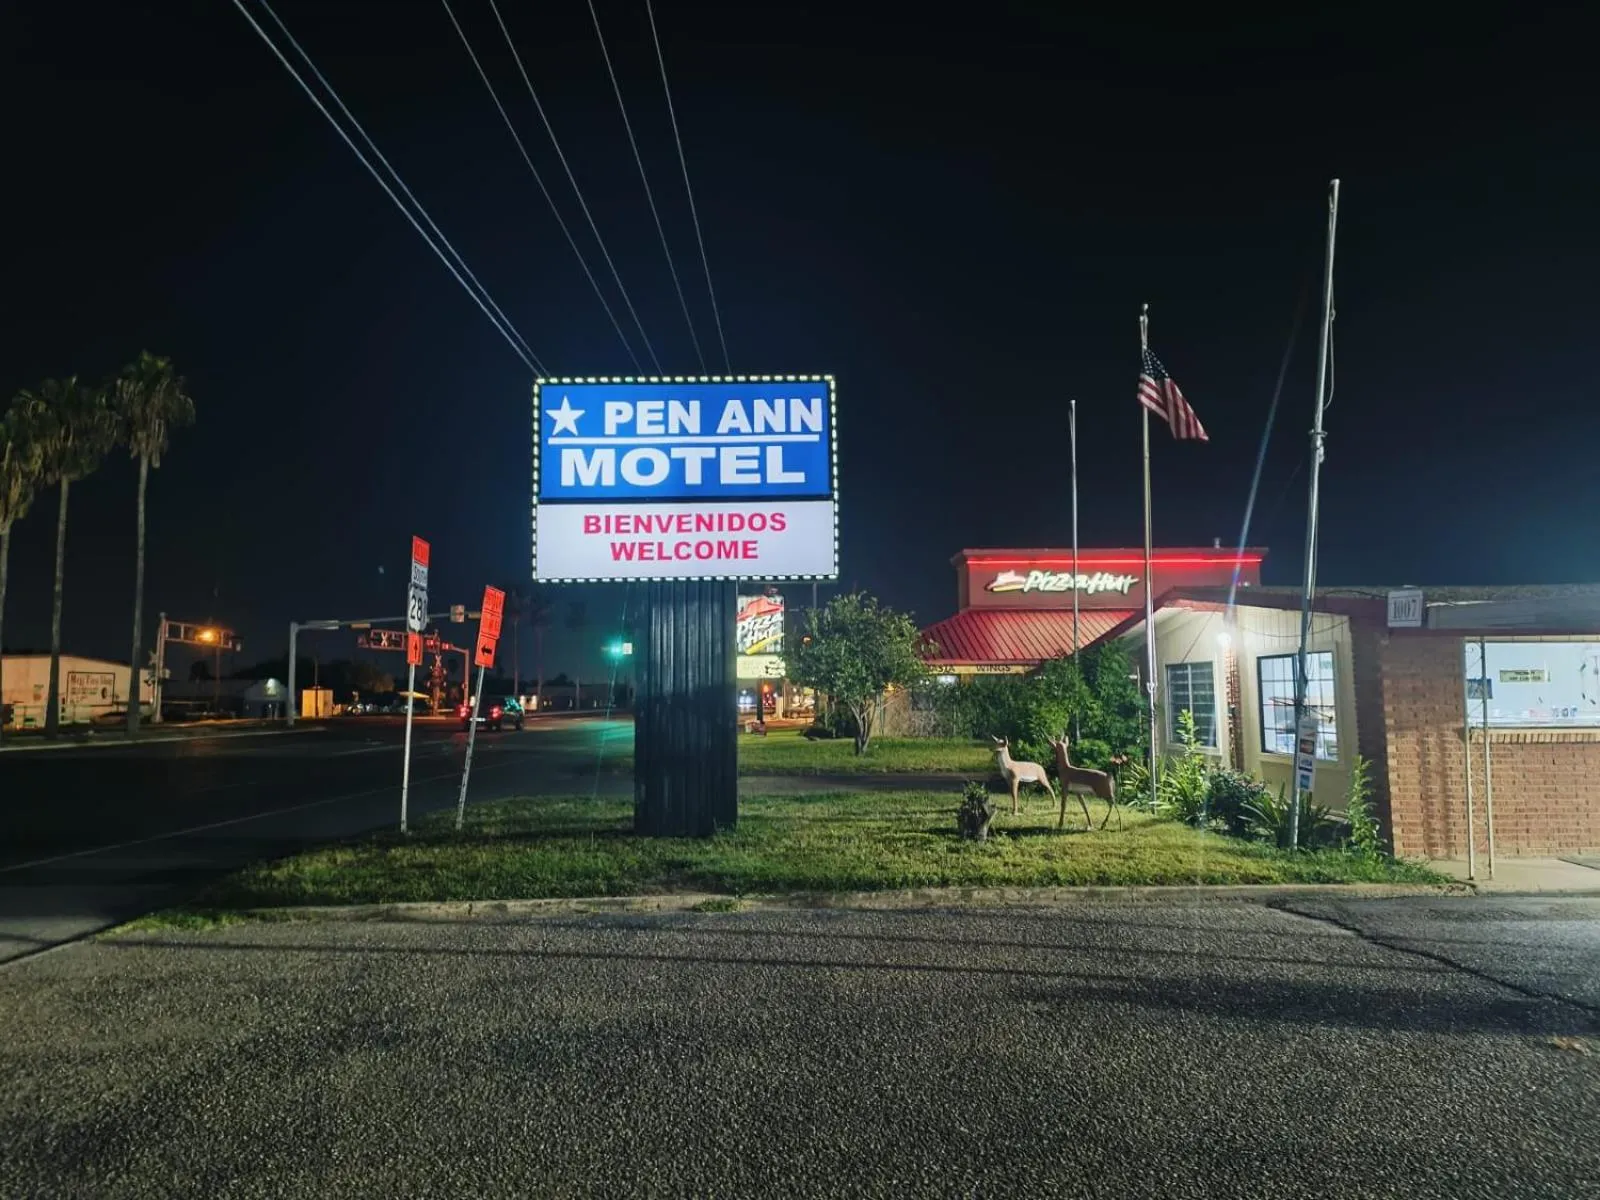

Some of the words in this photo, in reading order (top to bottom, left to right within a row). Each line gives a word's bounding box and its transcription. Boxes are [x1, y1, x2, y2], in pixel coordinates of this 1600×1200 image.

[604, 400, 701, 436] PEN
[716, 398, 823, 434] ANN
[560, 445, 806, 487] MOTEL
[583, 512, 787, 535] BIENVENIDOS
[610, 540, 759, 561] WELCOME
[1023, 570, 1089, 593] Pizza
[1086, 571, 1139, 595] Hut
[737, 612, 784, 645] Pizza
[976, 663, 1011, 672] WINGS
